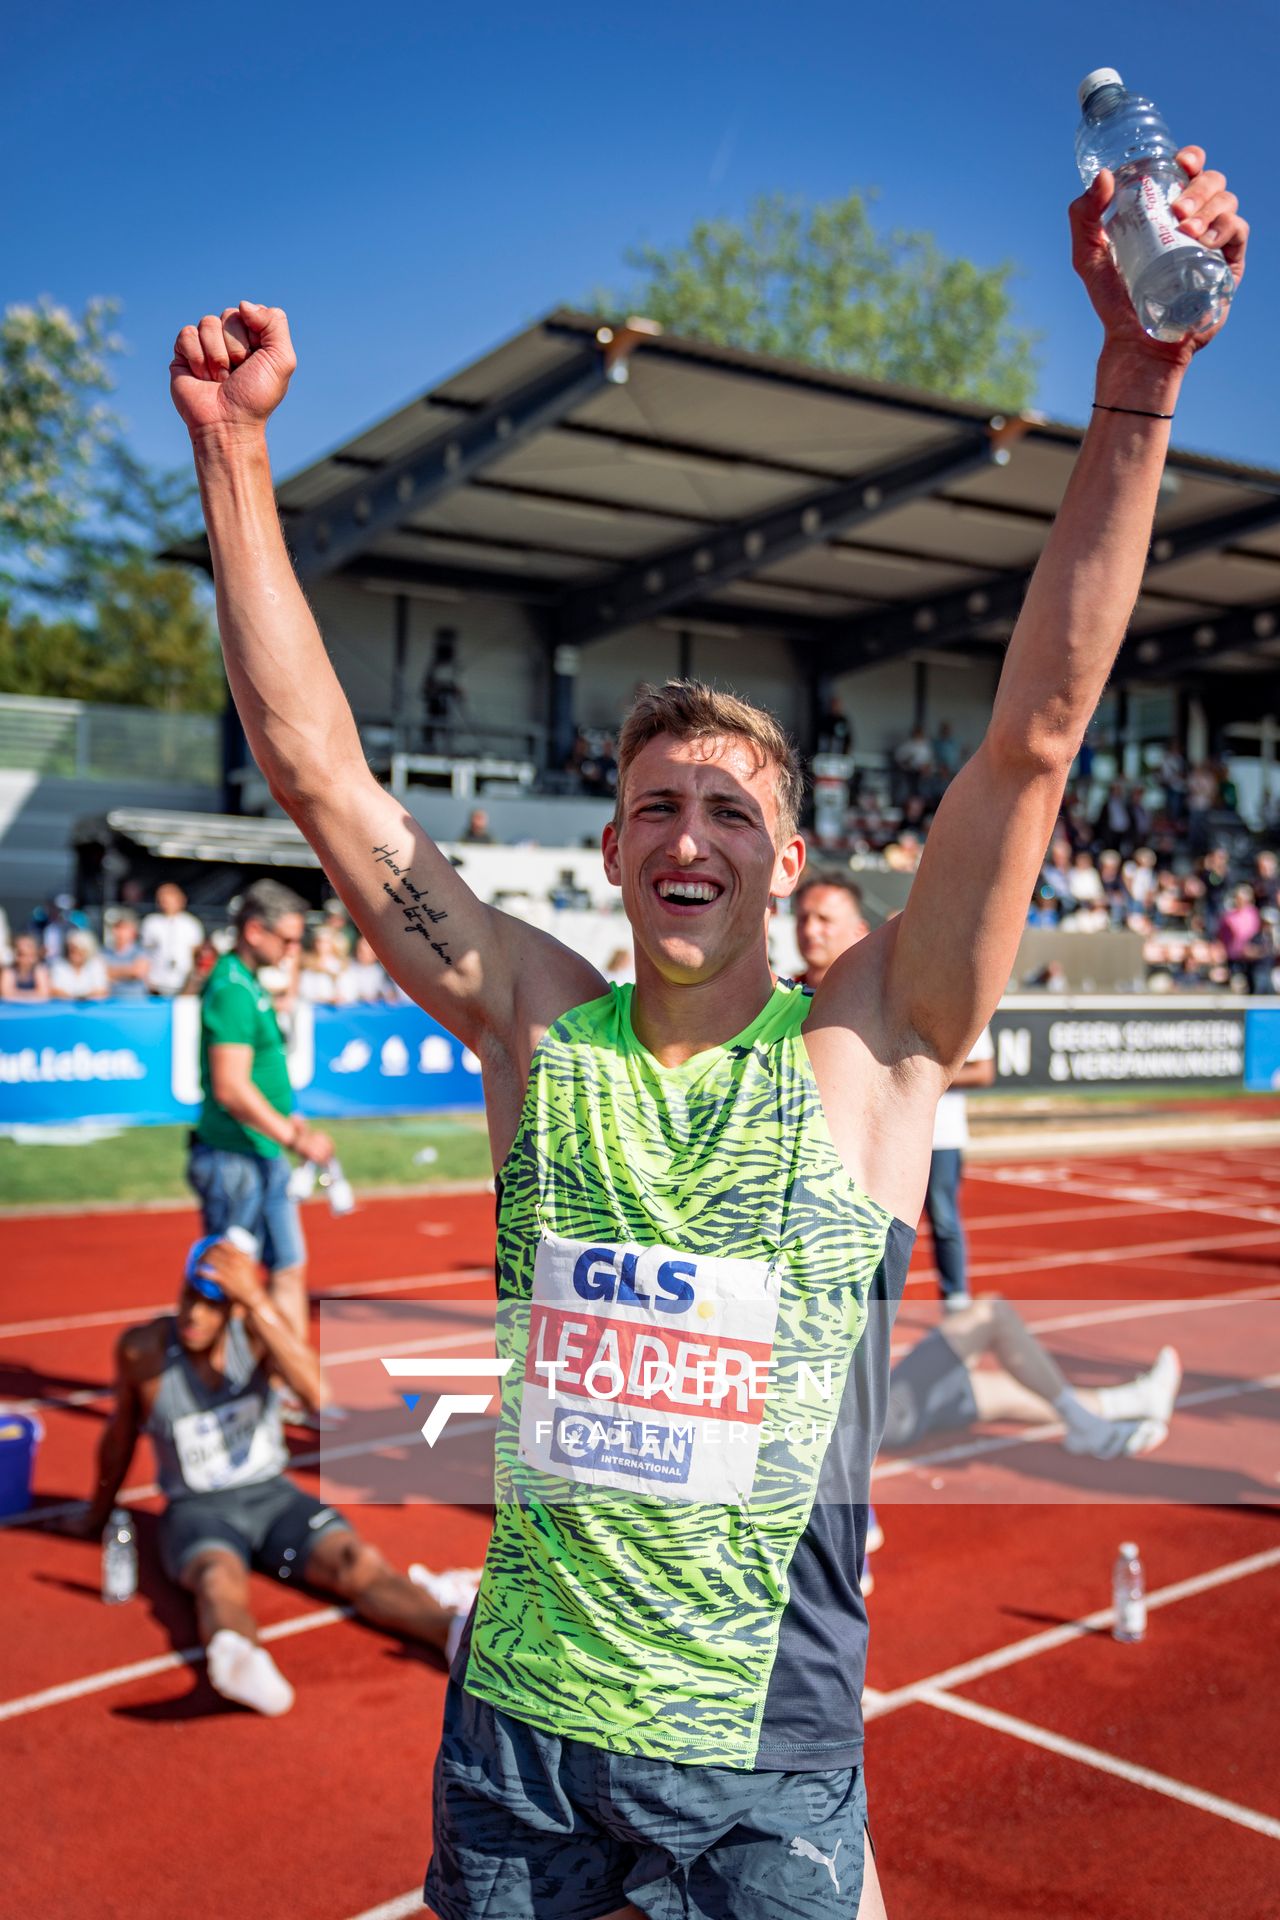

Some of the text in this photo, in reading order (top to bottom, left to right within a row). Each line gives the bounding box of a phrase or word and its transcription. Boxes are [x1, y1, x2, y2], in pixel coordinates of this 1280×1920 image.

[371, 844, 448, 924] Hard work will
[383, 882, 452, 966] never let you down
[535, 1316, 752, 1413] LEADER
[601, 1454, 682, 1477] INTERNATIONAL
[603, 1427, 687, 1464] PLAN
